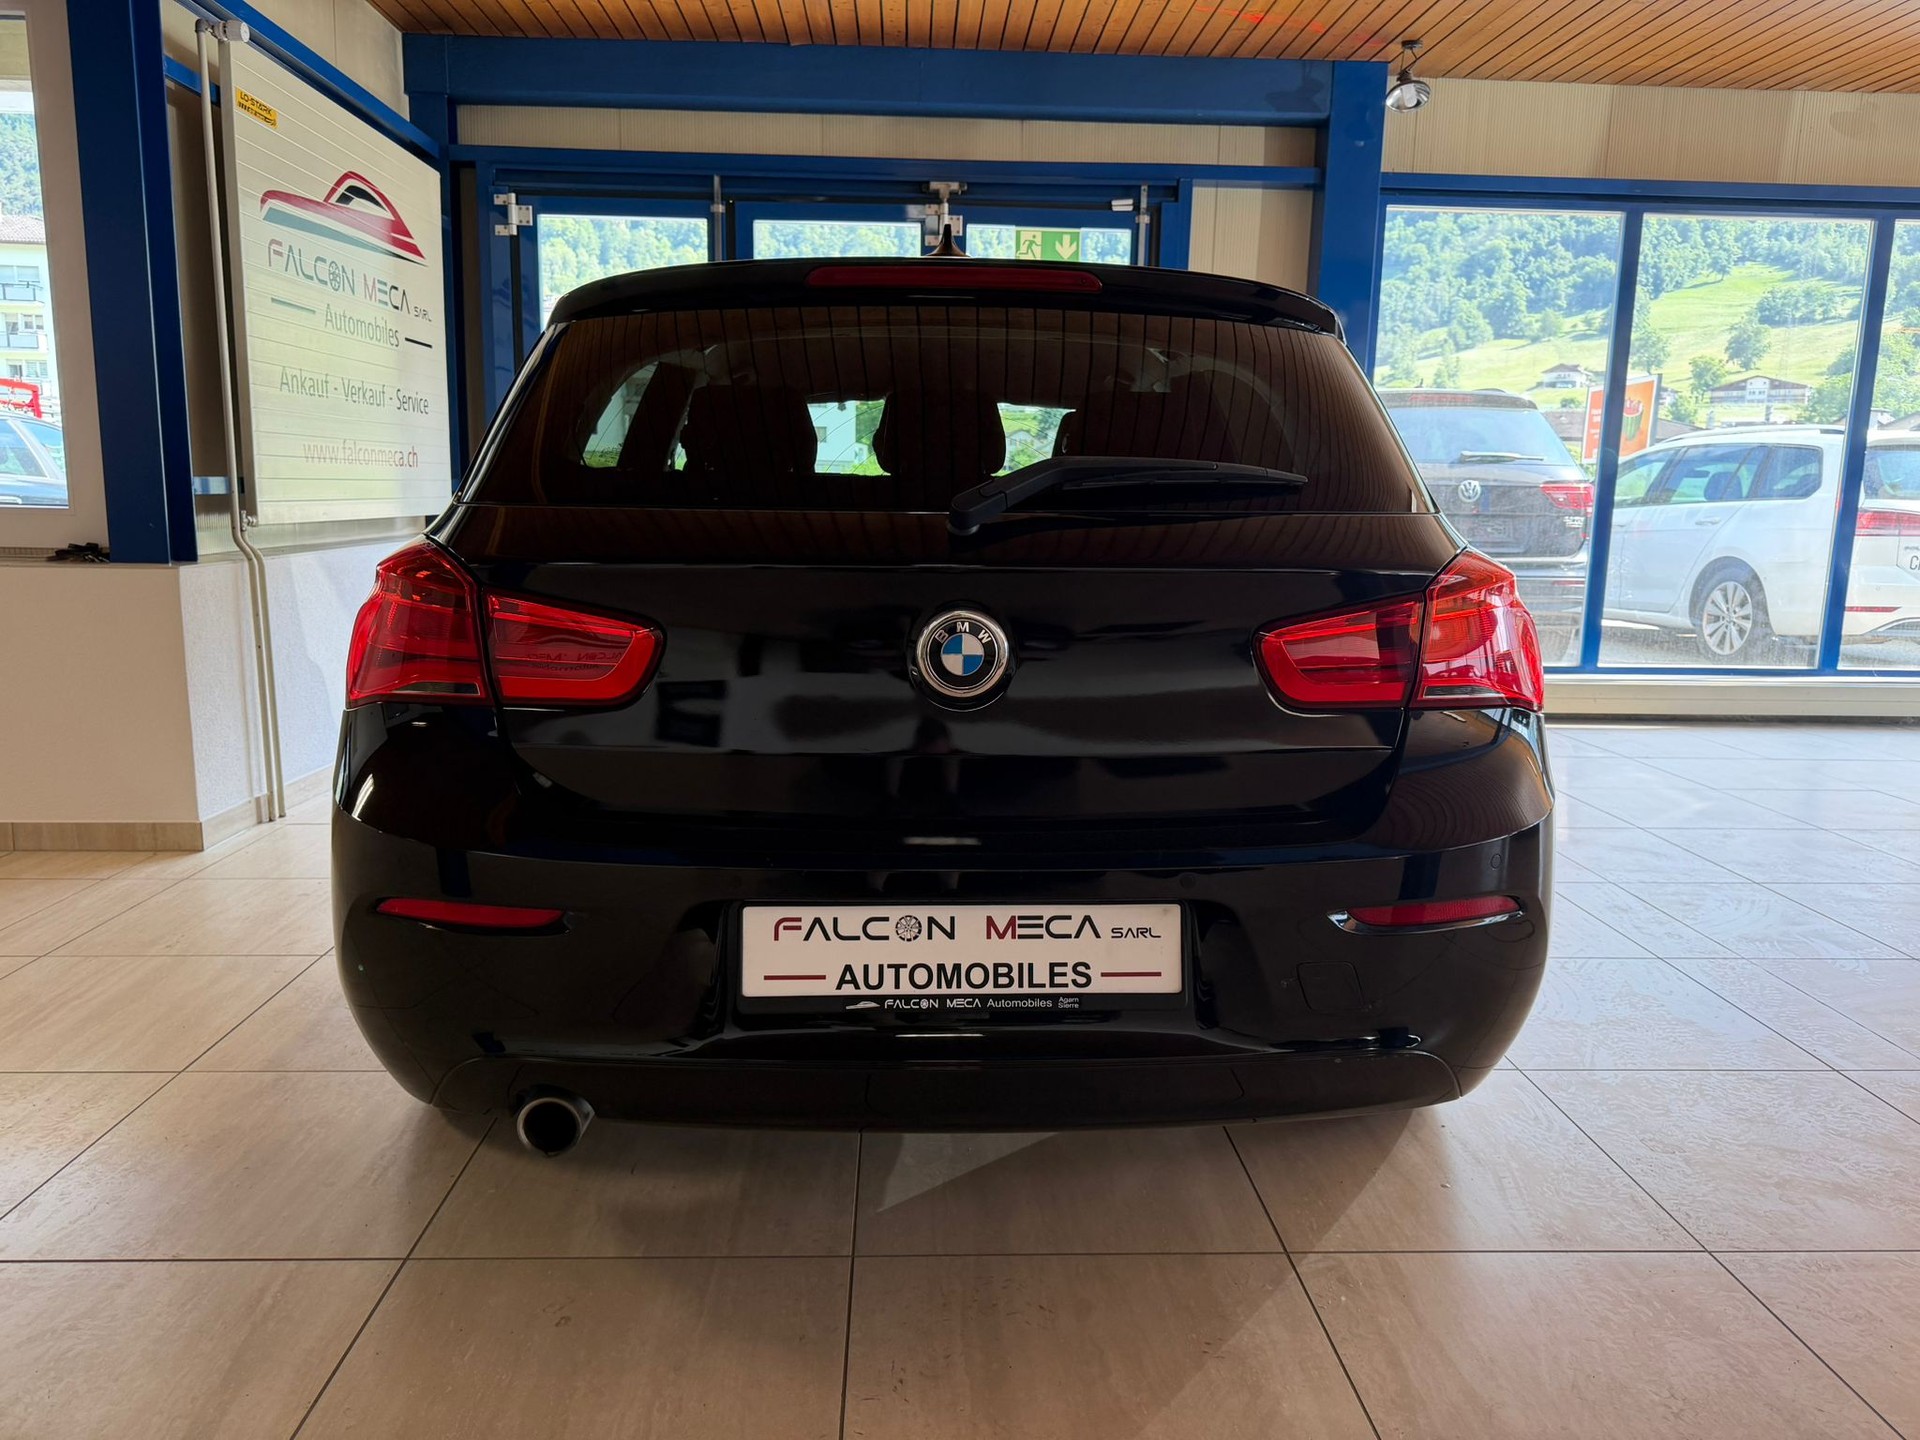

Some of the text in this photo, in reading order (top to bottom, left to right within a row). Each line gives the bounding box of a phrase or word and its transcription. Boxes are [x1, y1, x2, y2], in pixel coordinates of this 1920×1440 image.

[268, 238, 432, 322] FALCON MECA SARL
[325, 303, 400, 347] Automobiles
[279, 365, 330, 399] Ankauf
[341, 376, 386, 408] Verkauf
[396, 388, 430, 415] Service
[302, 438, 419, 468] www.falconmeca.ch
[935, 621, 992, 644] BMW
[773, 914, 1162, 942] FALCON MECA SARL
[835, 961, 1092, 991] AUTOMOBILES
[884, 997, 1053, 1009] FALCON MECA Automobiles
